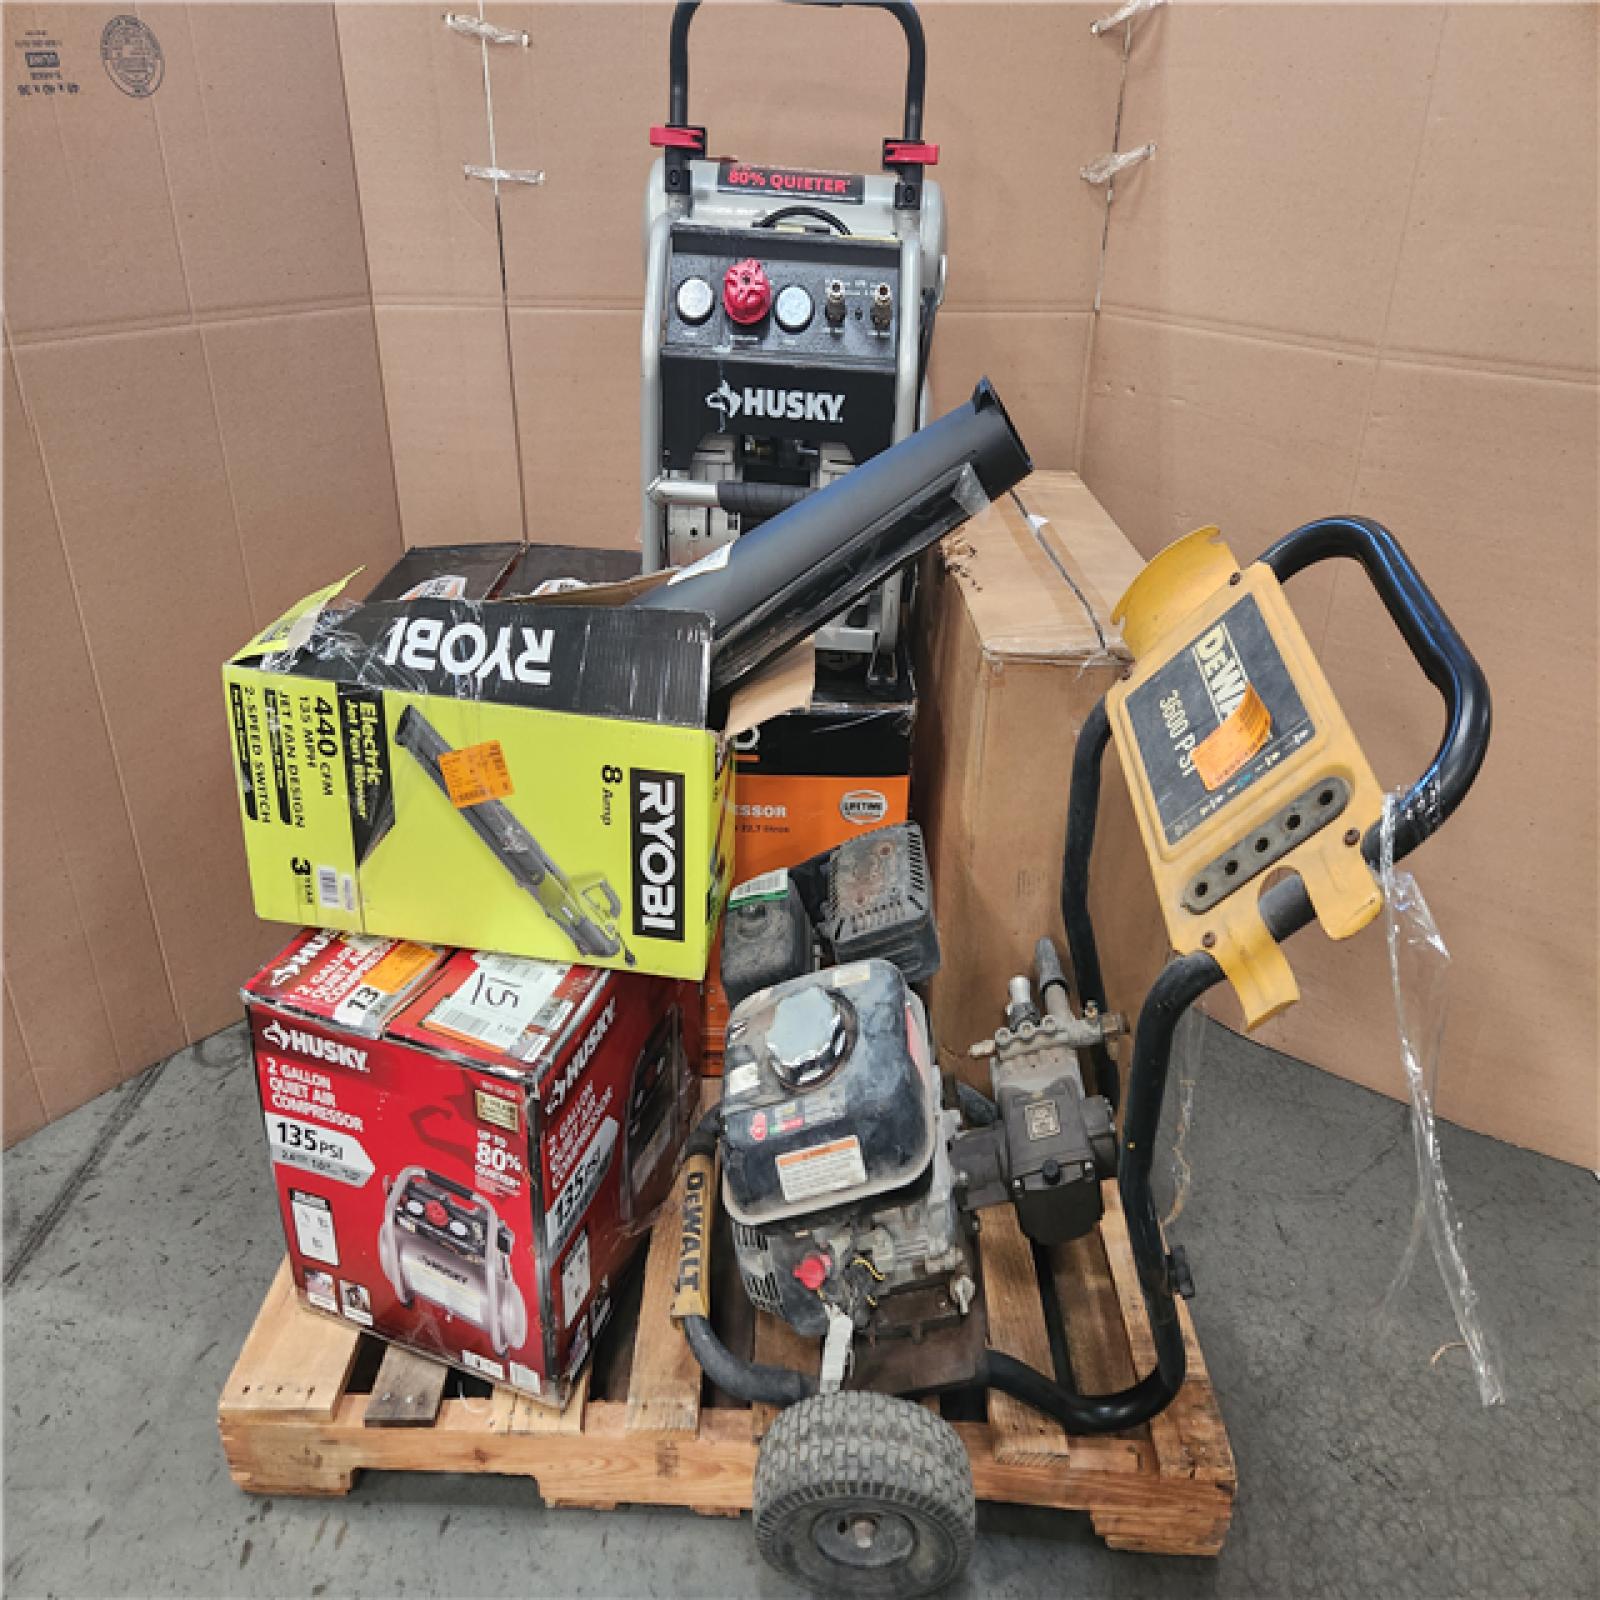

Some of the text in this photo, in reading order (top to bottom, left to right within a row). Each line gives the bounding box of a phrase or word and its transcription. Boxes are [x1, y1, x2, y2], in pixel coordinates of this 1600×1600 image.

[769, 174, 847, 193] QUIETER
[743, 386, 846, 423] HUSKY
[381, 617, 555, 685] RYOBI
[284, 724, 296, 760] FAN
[314, 696, 338, 757] 440
[360, 701, 383, 786] Electric
[254, 761, 272, 824] SWITCH
[289, 764, 306, 829] DESIGN
[600, 764, 623, 827] 8 Amp
[291, 856, 311, 876] 3
[639, 779, 676, 932] RYOBI
[281, 1064, 331, 1090] GALLON
[289, 1030, 370, 1073] HUSKY
[272, 1094, 364, 1133] COMPRESSOR
[277, 1121, 343, 1161] 135 PSI
[677, 1171, 704, 1294] DEWALT
